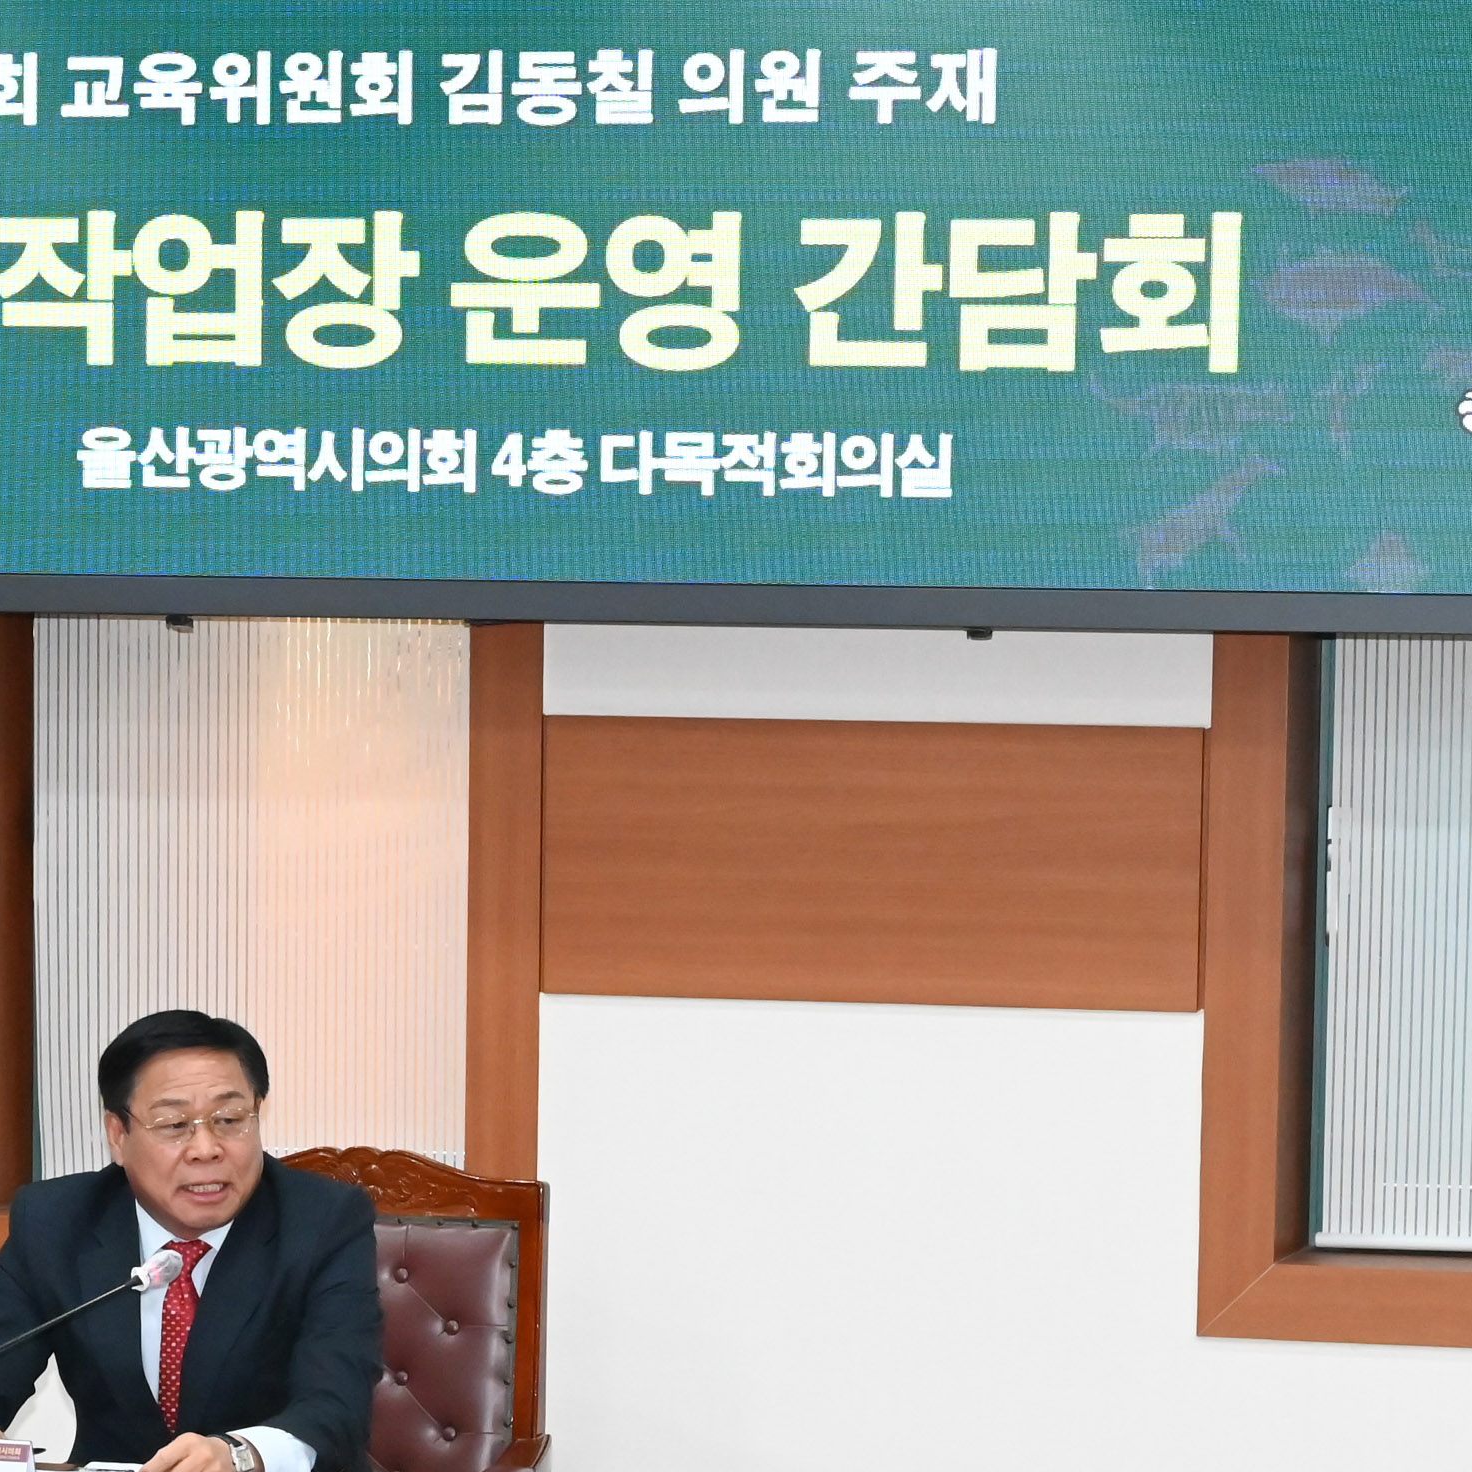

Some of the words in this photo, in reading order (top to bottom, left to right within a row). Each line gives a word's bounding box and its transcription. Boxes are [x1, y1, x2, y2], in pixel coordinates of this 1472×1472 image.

[60, 50, 413, 126] 교육위원회
[440, 49, 654, 127] 김동칠
[678, 48, 821, 124] 의원
[848, 47, 998, 125] 주재
[450, 210, 742, 372] 운영
[793, 210, 1242, 373] 간담회
[76, 426, 477, 493] 울산광역시의회
[491, 429, 589, 495] 4층
[600, 431, 953, 498] 다목적회의실
